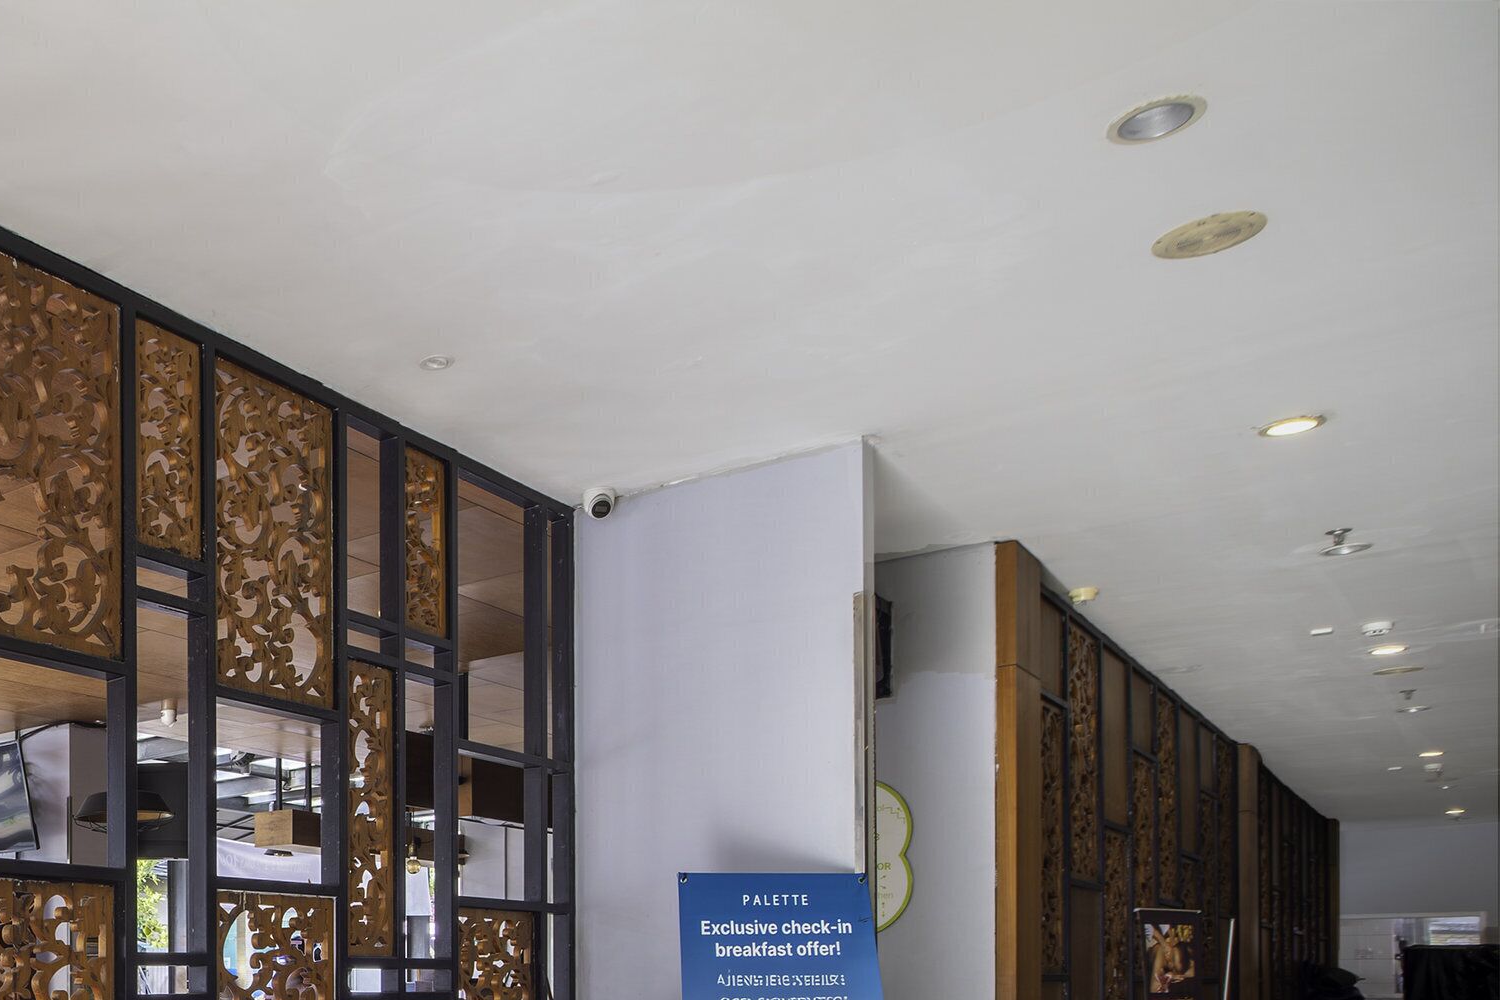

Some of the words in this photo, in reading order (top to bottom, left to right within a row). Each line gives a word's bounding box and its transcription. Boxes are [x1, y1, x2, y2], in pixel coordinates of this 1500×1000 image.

[742, 894, 809, 906] PALETTE
[700, 920, 778, 935] Exclusive
[781, 919, 853, 935] check-in
[715, 942, 793, 957] breakfast
[796, 941, 841, 956] offer!
